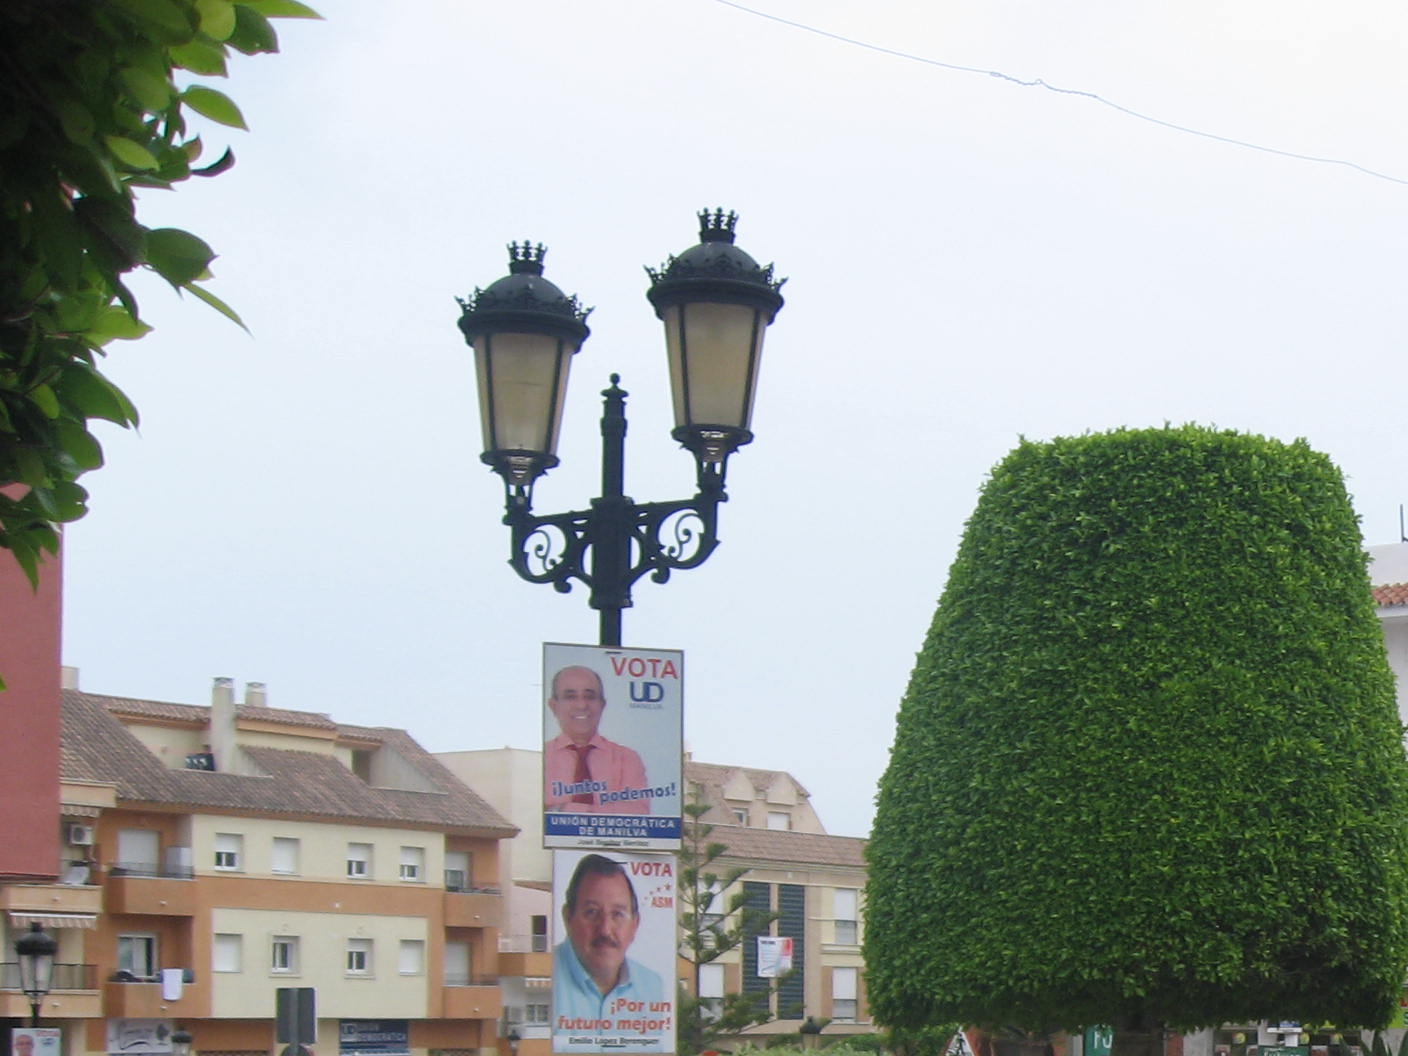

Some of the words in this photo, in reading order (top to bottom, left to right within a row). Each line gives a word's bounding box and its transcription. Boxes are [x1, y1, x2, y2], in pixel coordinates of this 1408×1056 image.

[610, 656, 678, 679] VOTA
[629, 681, 664, 702] UD
[552, 780, 607, 796] ¡Juntos
[600, 783, 676, 805] podemos!
[551, 814, 588, 826] UNIÓN
[590, 816, 675, 829] DEMOCRÁTICA
[578, 825, 594, 836] DE
[597, 826, 648, 837] MANILVA
[631, 862, 673, 877] VOTA
[651, 896, 673, 908] ASM
[610, 998, 645, 1015] ¡Por
[649, 1001, 671, 1012] un
[557, 1016, 612, 1030] futuro
[616, 1017, 671, 1035] mejor!
[568, 1036, 593, 1045] Emilio
